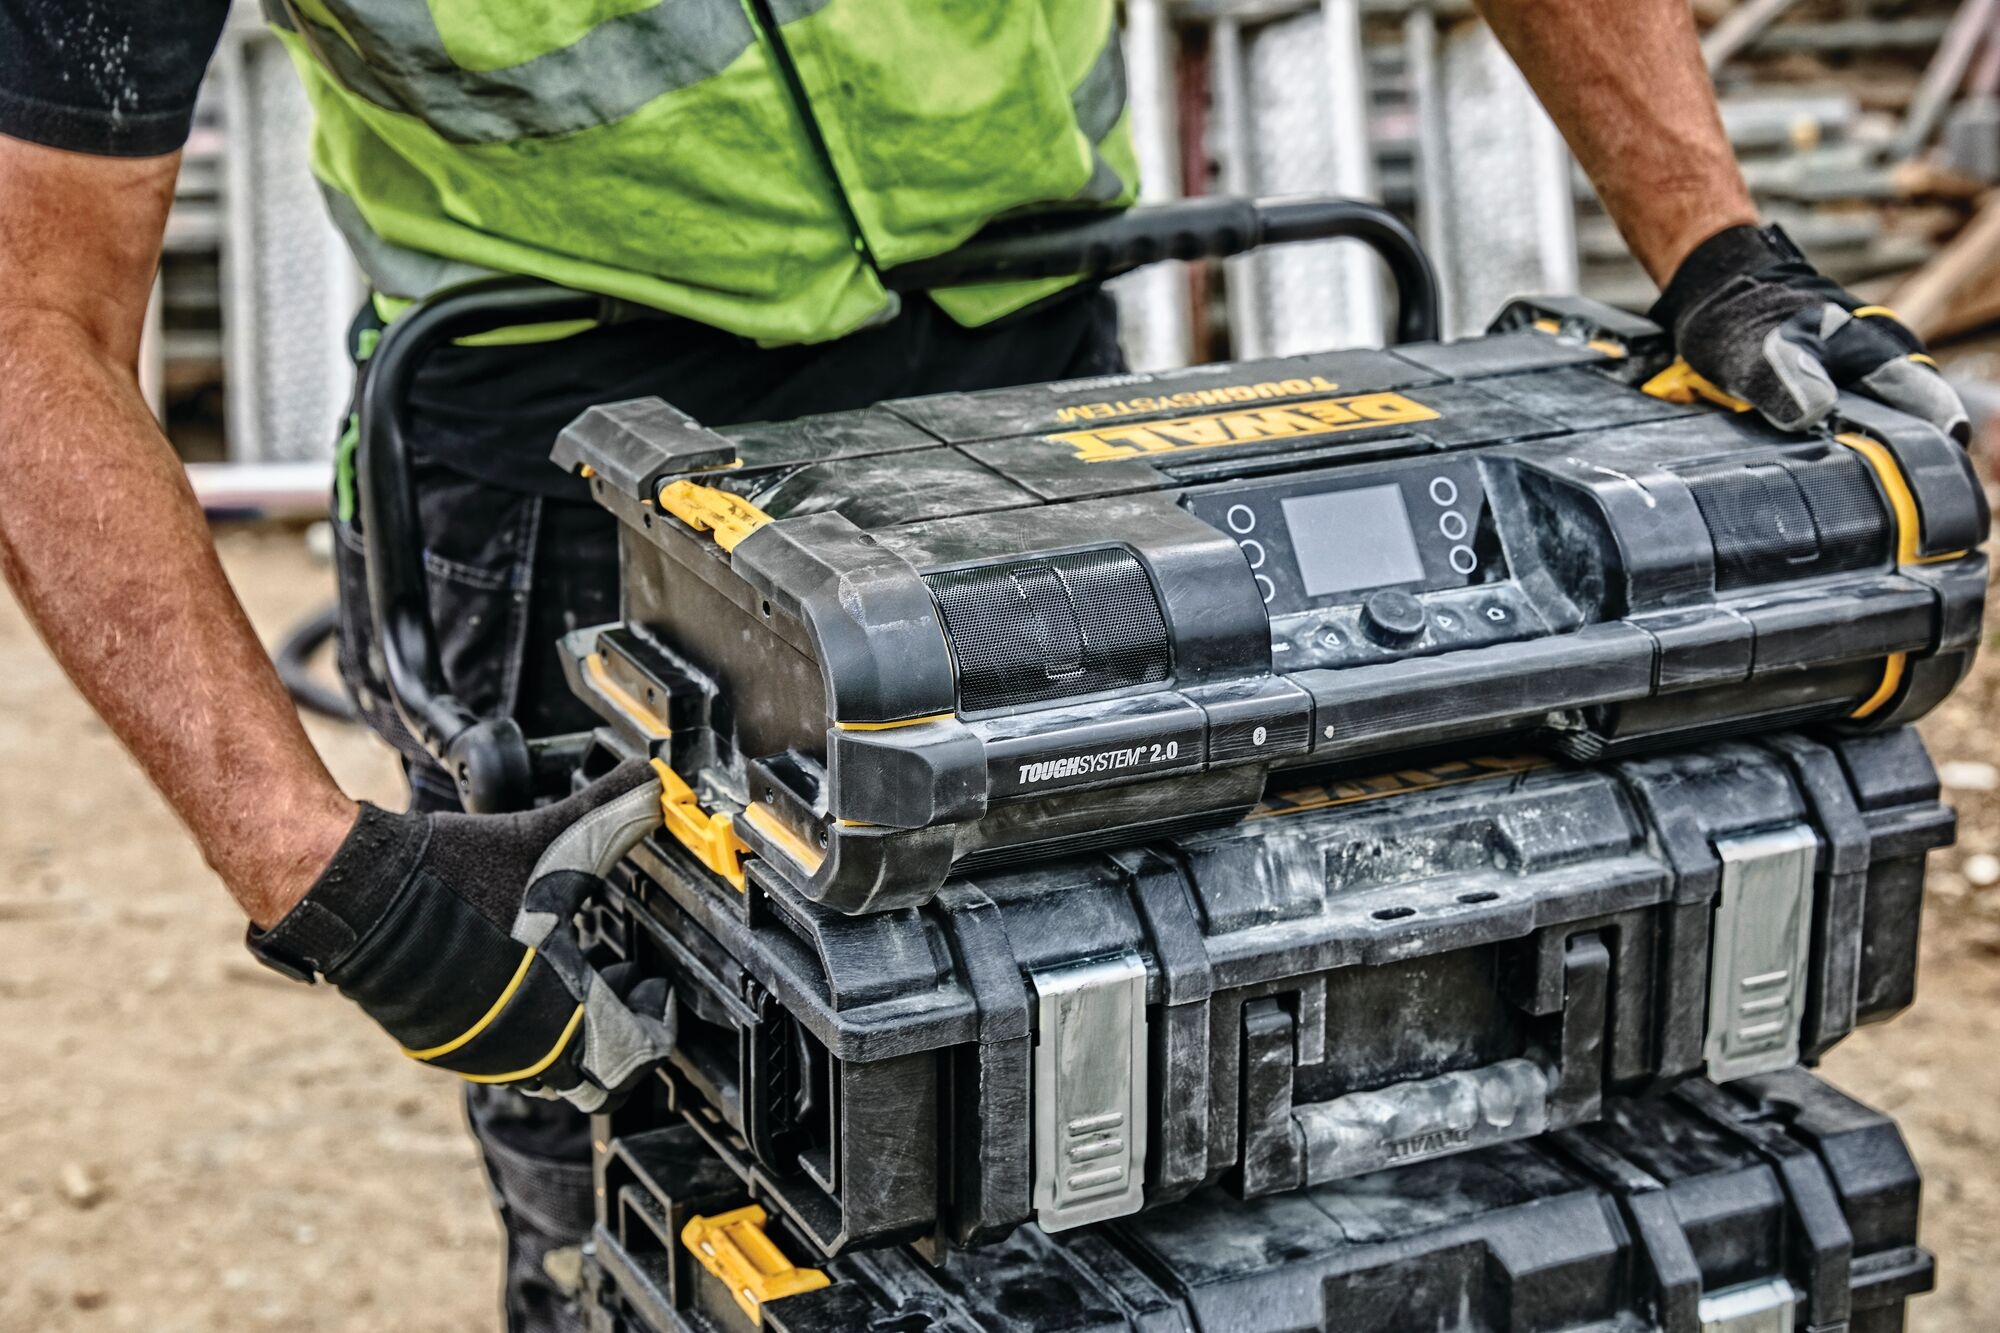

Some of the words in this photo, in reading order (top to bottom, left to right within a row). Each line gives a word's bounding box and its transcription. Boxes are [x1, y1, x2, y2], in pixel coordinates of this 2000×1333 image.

[1056, 376, 1339, 423] TOUGHSYSTEM
[1048, 392, 1441, 463] DEWALT
[1149, 740, 1179, 762] 2.0
